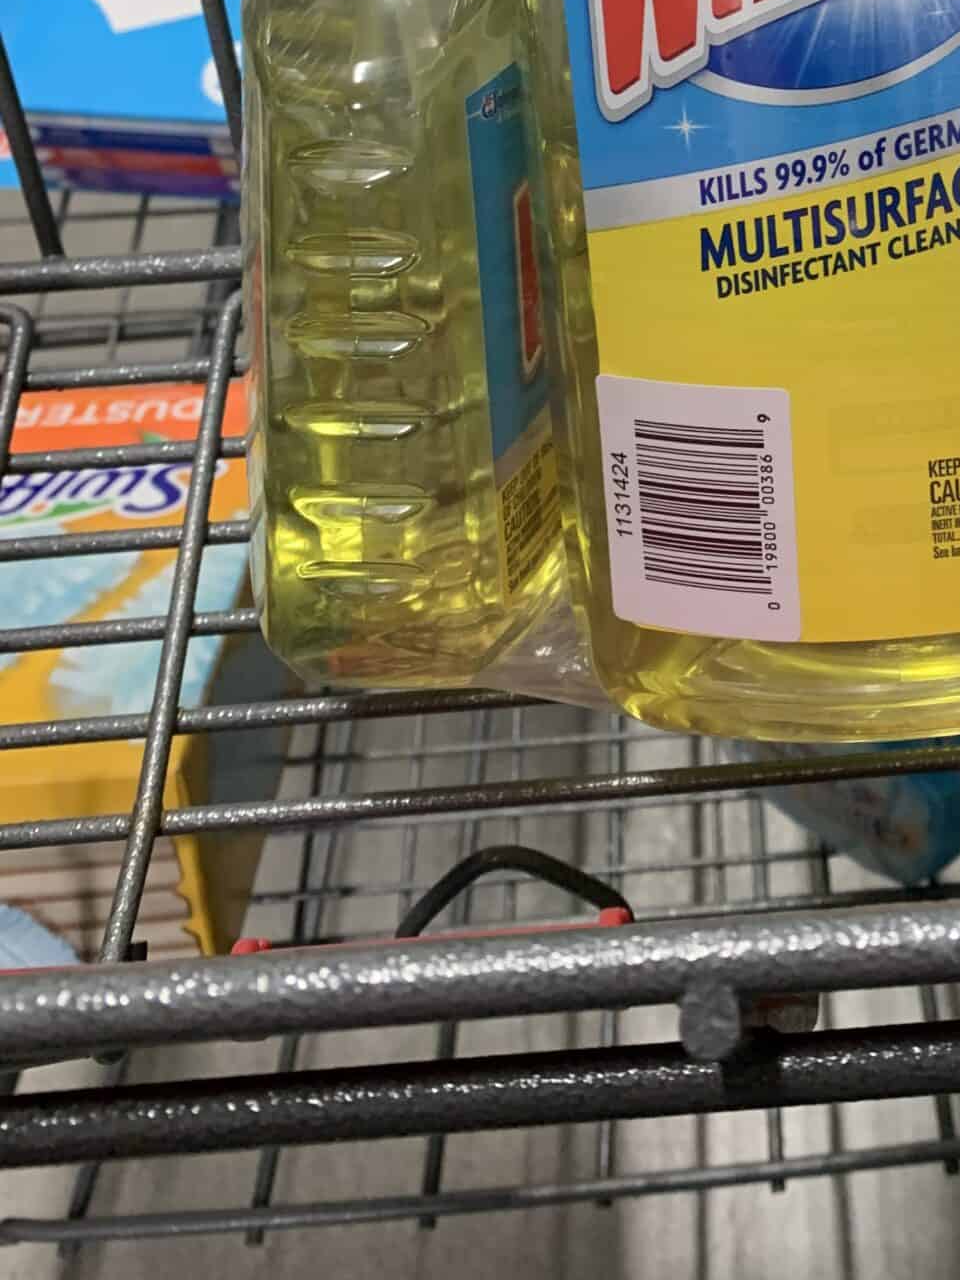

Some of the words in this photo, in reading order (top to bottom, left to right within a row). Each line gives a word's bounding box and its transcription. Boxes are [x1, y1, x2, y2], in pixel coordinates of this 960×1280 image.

[699, 167, 768, 206] KILLS
[775, 149, 849, 190] 99.9%
[858, 138, 887, 171] of
[716, 242, 881, 299] DISINFECTANT
[756, 413, 771, 423] 9
[759, 454, 775, 505] 00386
[928, 457, 960, 478] KEEP
[611, 452, 633, 538] 1131424
[763, 521, 778, 572] 19800
[933, 546, 949, 559] See
[767, 601, 781, 610] 0
